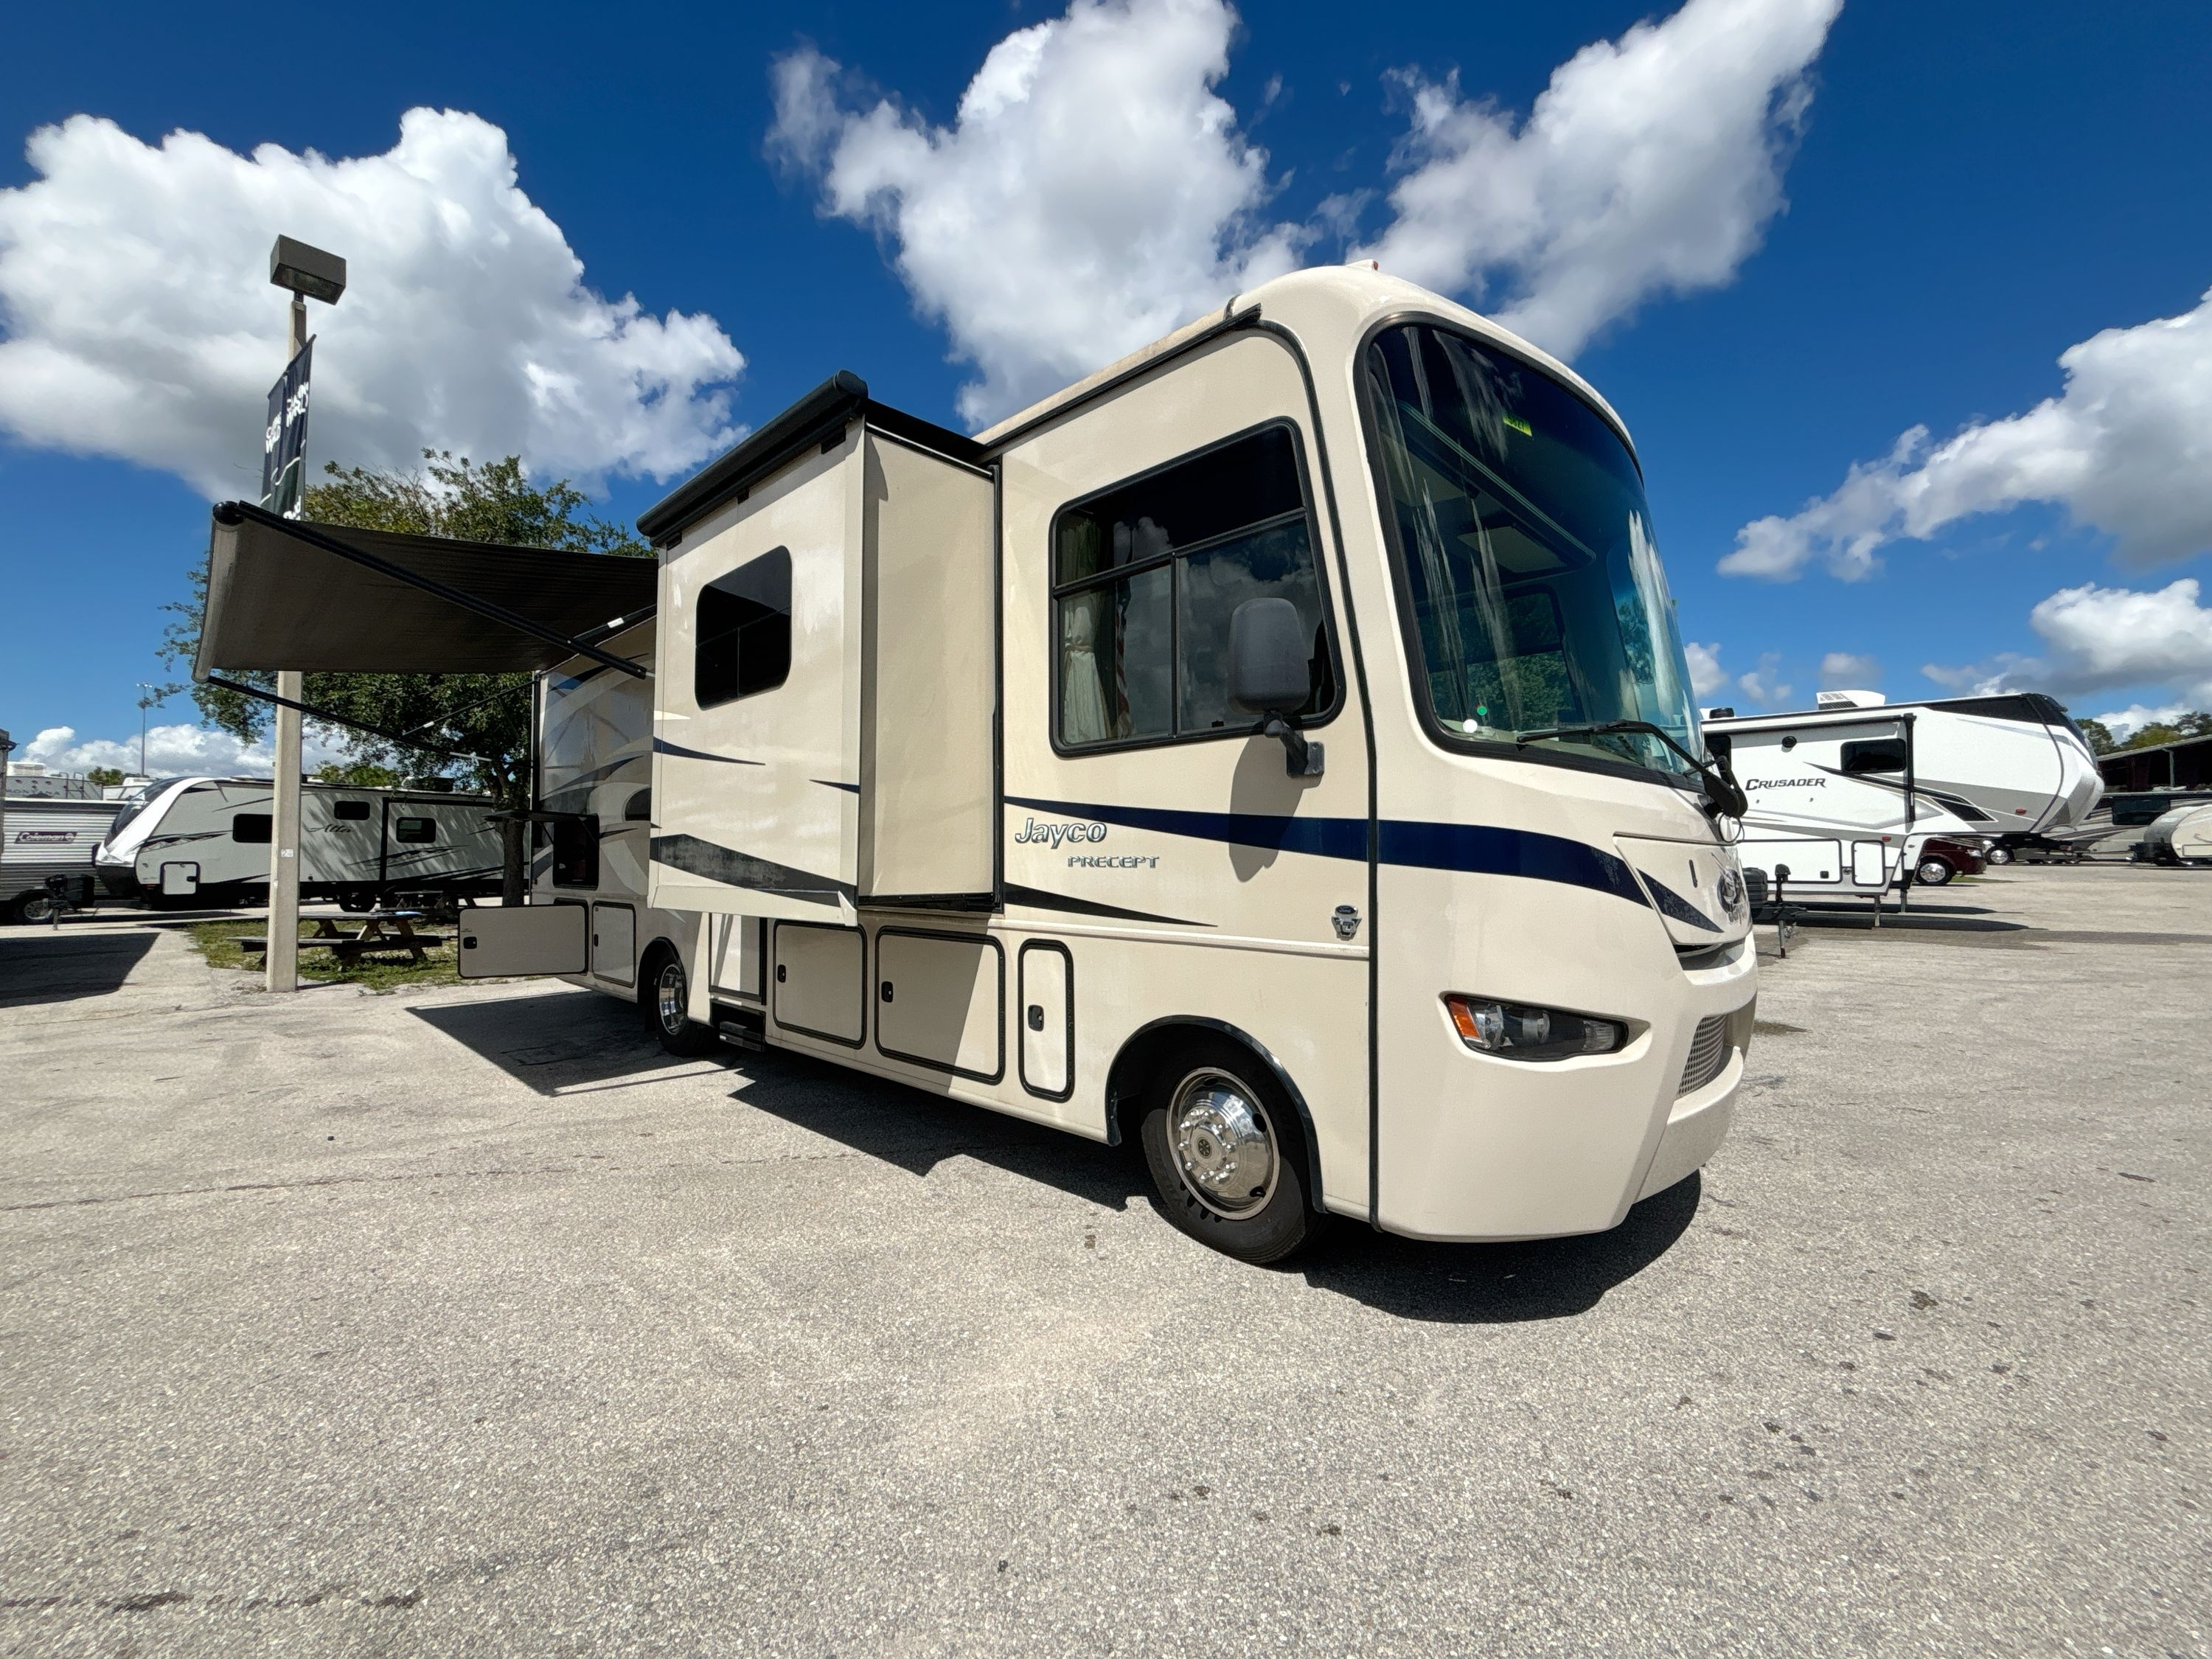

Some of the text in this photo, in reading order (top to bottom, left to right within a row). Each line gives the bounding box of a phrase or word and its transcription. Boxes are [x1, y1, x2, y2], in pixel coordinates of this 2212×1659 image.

[19, 832, 64, 841] Coleman
[1015, 818, 1107, 849] Jayco
[1068, 856, 1160, 869] PRECEPT
